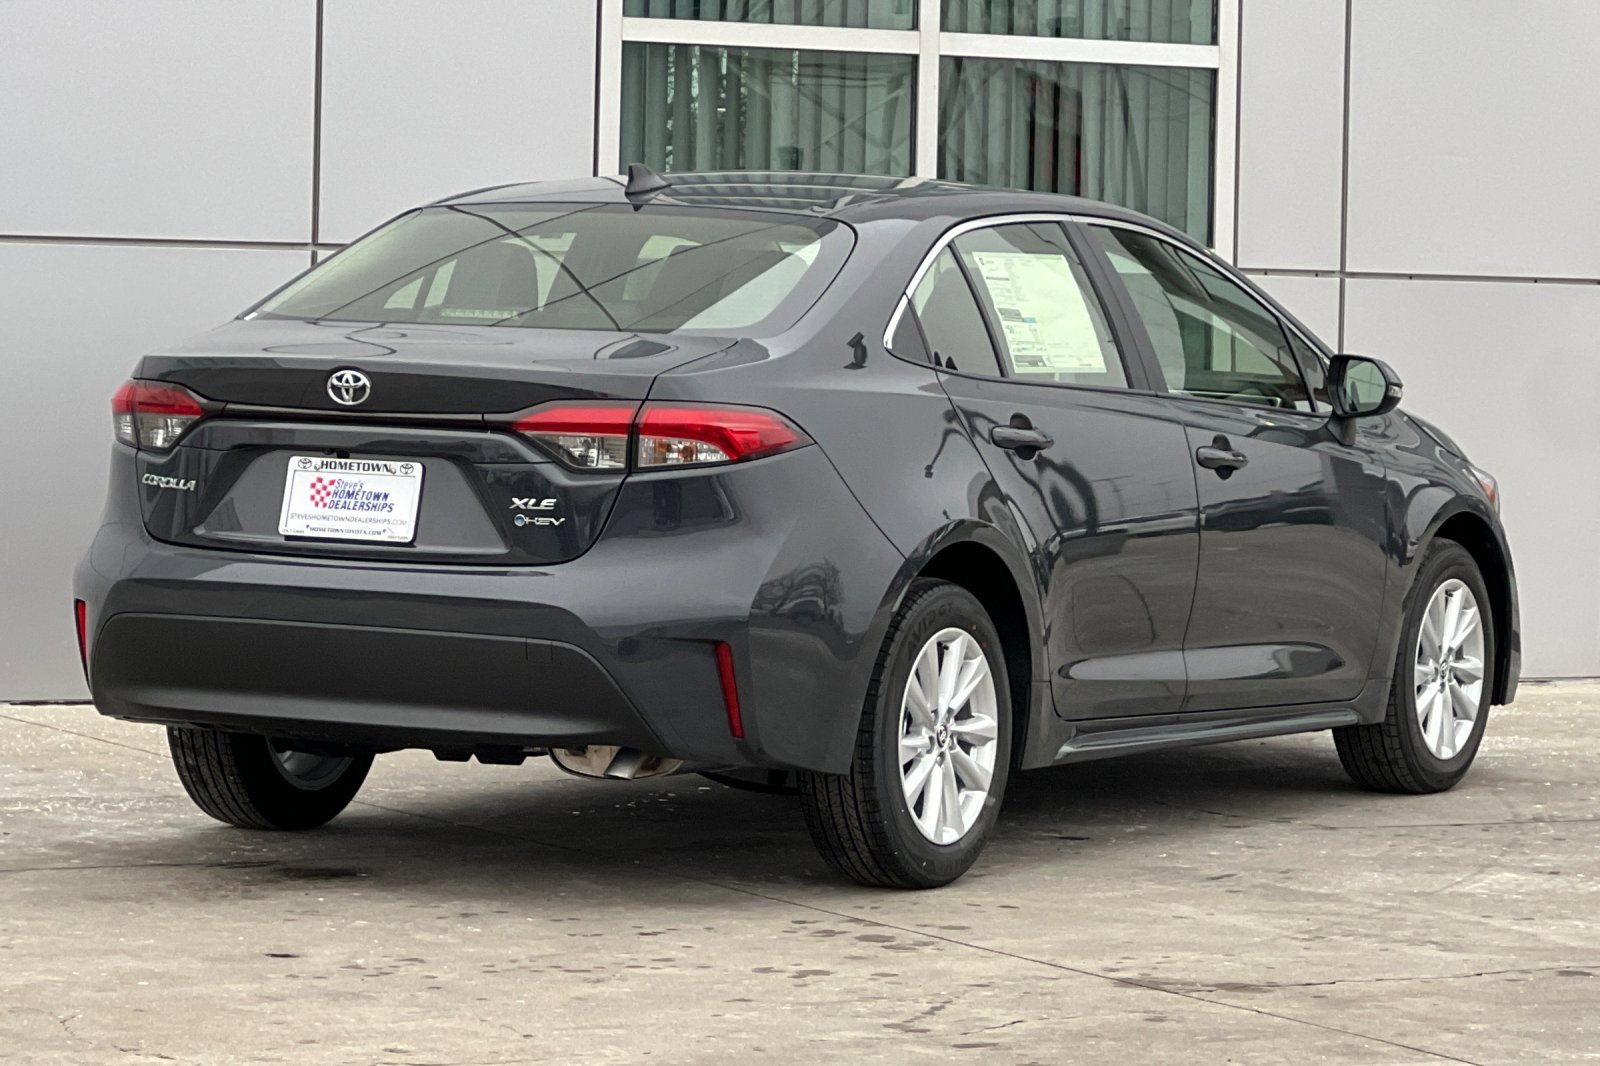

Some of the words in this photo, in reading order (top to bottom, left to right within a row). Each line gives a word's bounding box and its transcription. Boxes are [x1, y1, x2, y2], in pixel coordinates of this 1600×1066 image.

[320, 460, 391, 472] HOMETOWN
[142, 473, 196, 491] COROLLA
[335, 478, 364, 490] Steve's
[331, 489, 390, 502] HOMETOWN
[328, 500, 395, 513] DEALERSHIPS
[508, 497, 557, 510] XLE
[525, 516, 566, 526] HEV
